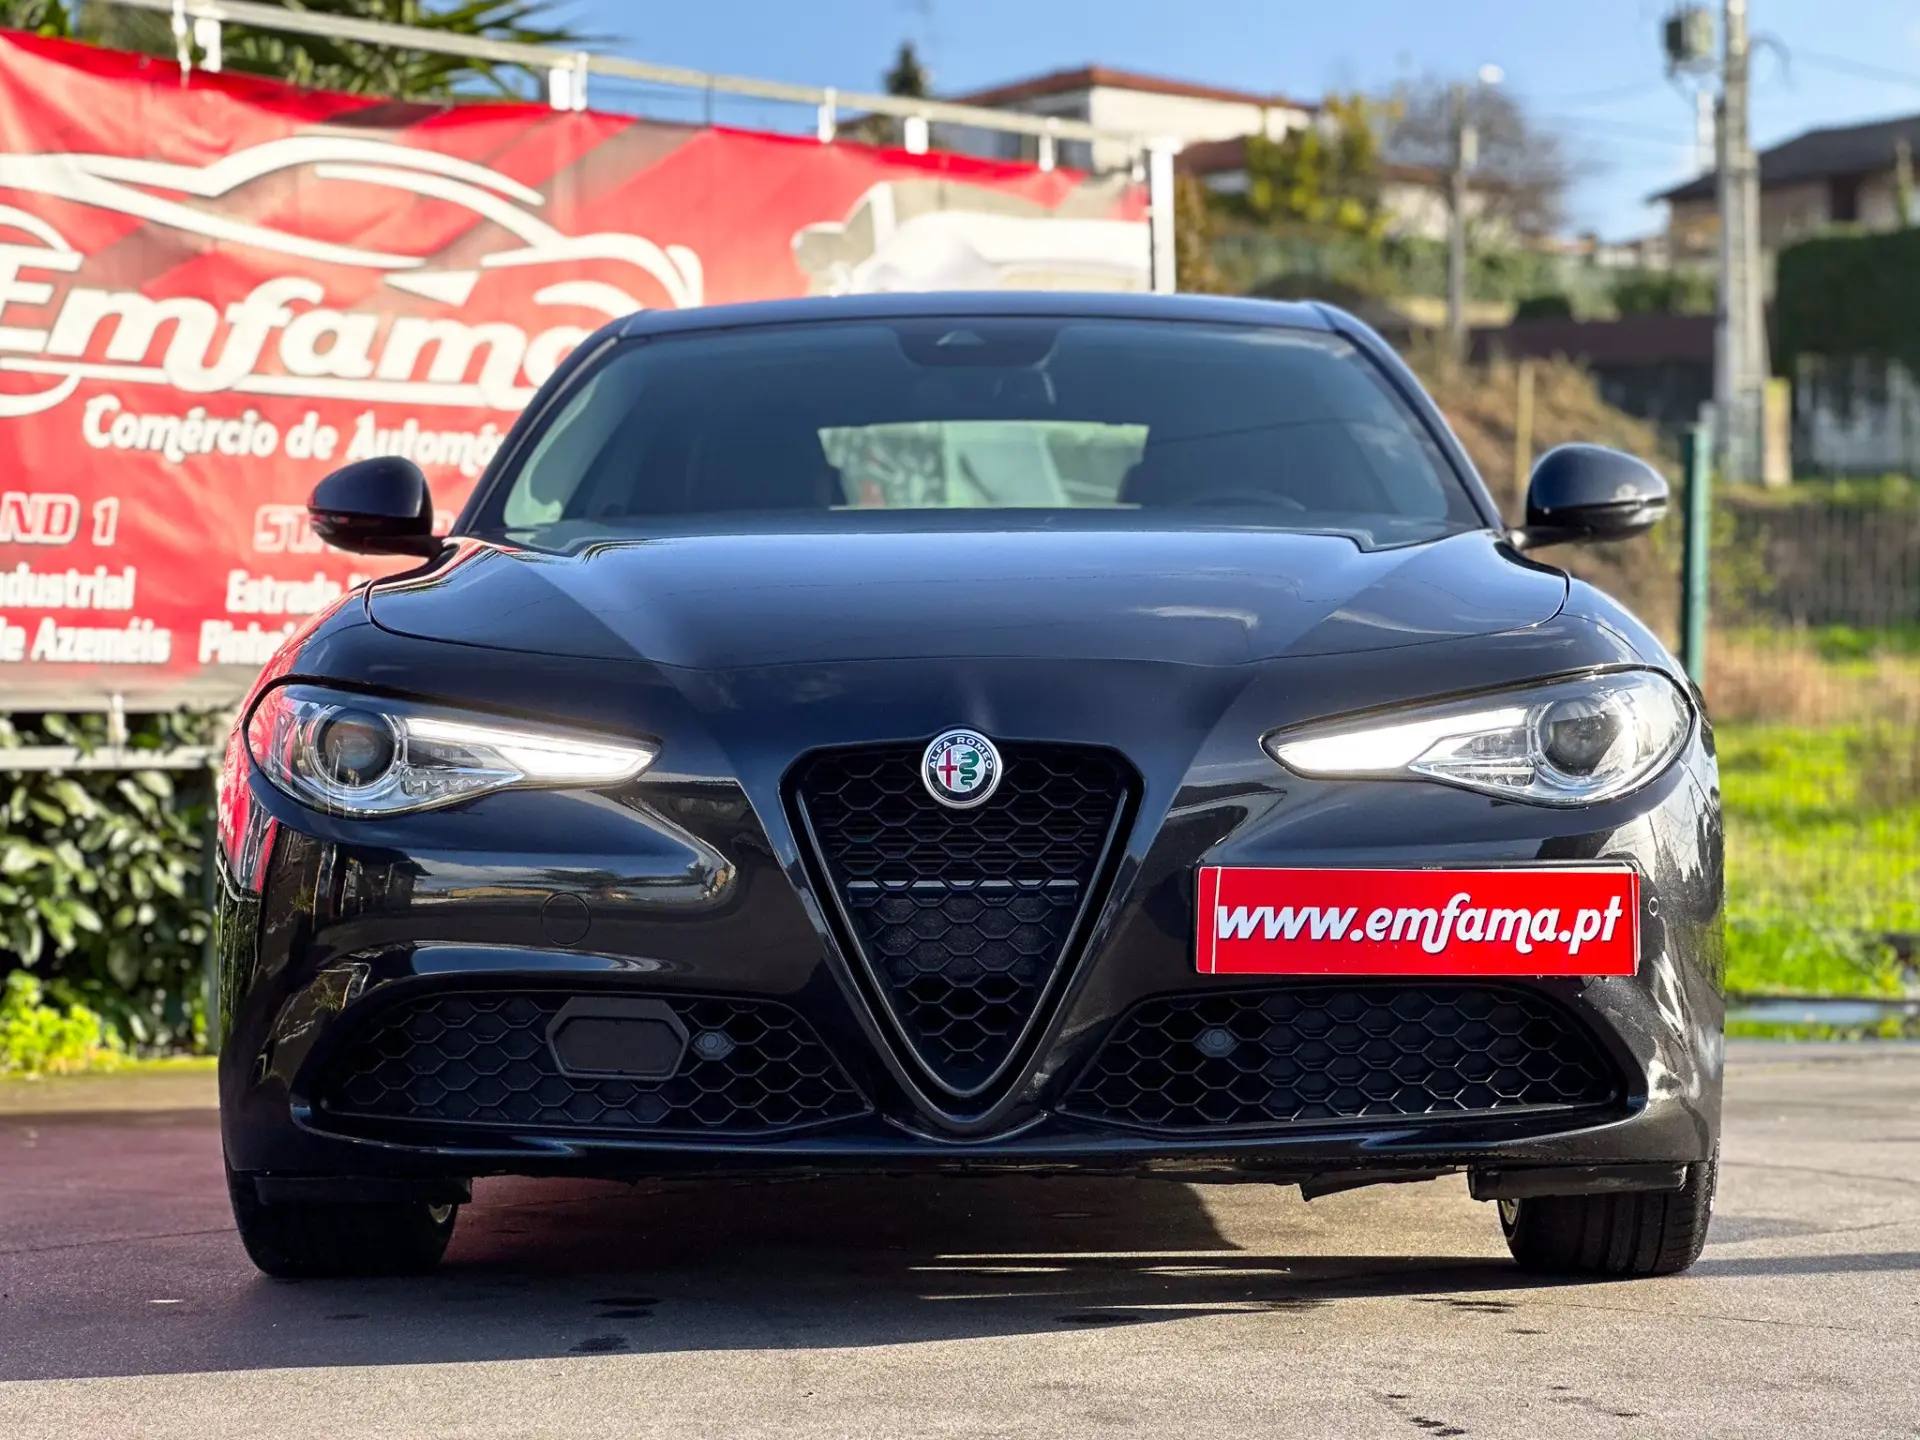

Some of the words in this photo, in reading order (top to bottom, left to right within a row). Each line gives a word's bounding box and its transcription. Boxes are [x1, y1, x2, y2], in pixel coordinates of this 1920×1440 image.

[83, 395, 278, 463] Comércio
[285, 411, 339, 461] de
[345, 409, 505, 477] Automó
[92, 496, 119, 546] 1
[30, 616, 172, 664] Azeméis
[929, 740, 952, 769] ALFA
[956, 736, 993, 769] ROMEO
[1217, 892, 1623, 955] www.emfama.pt
